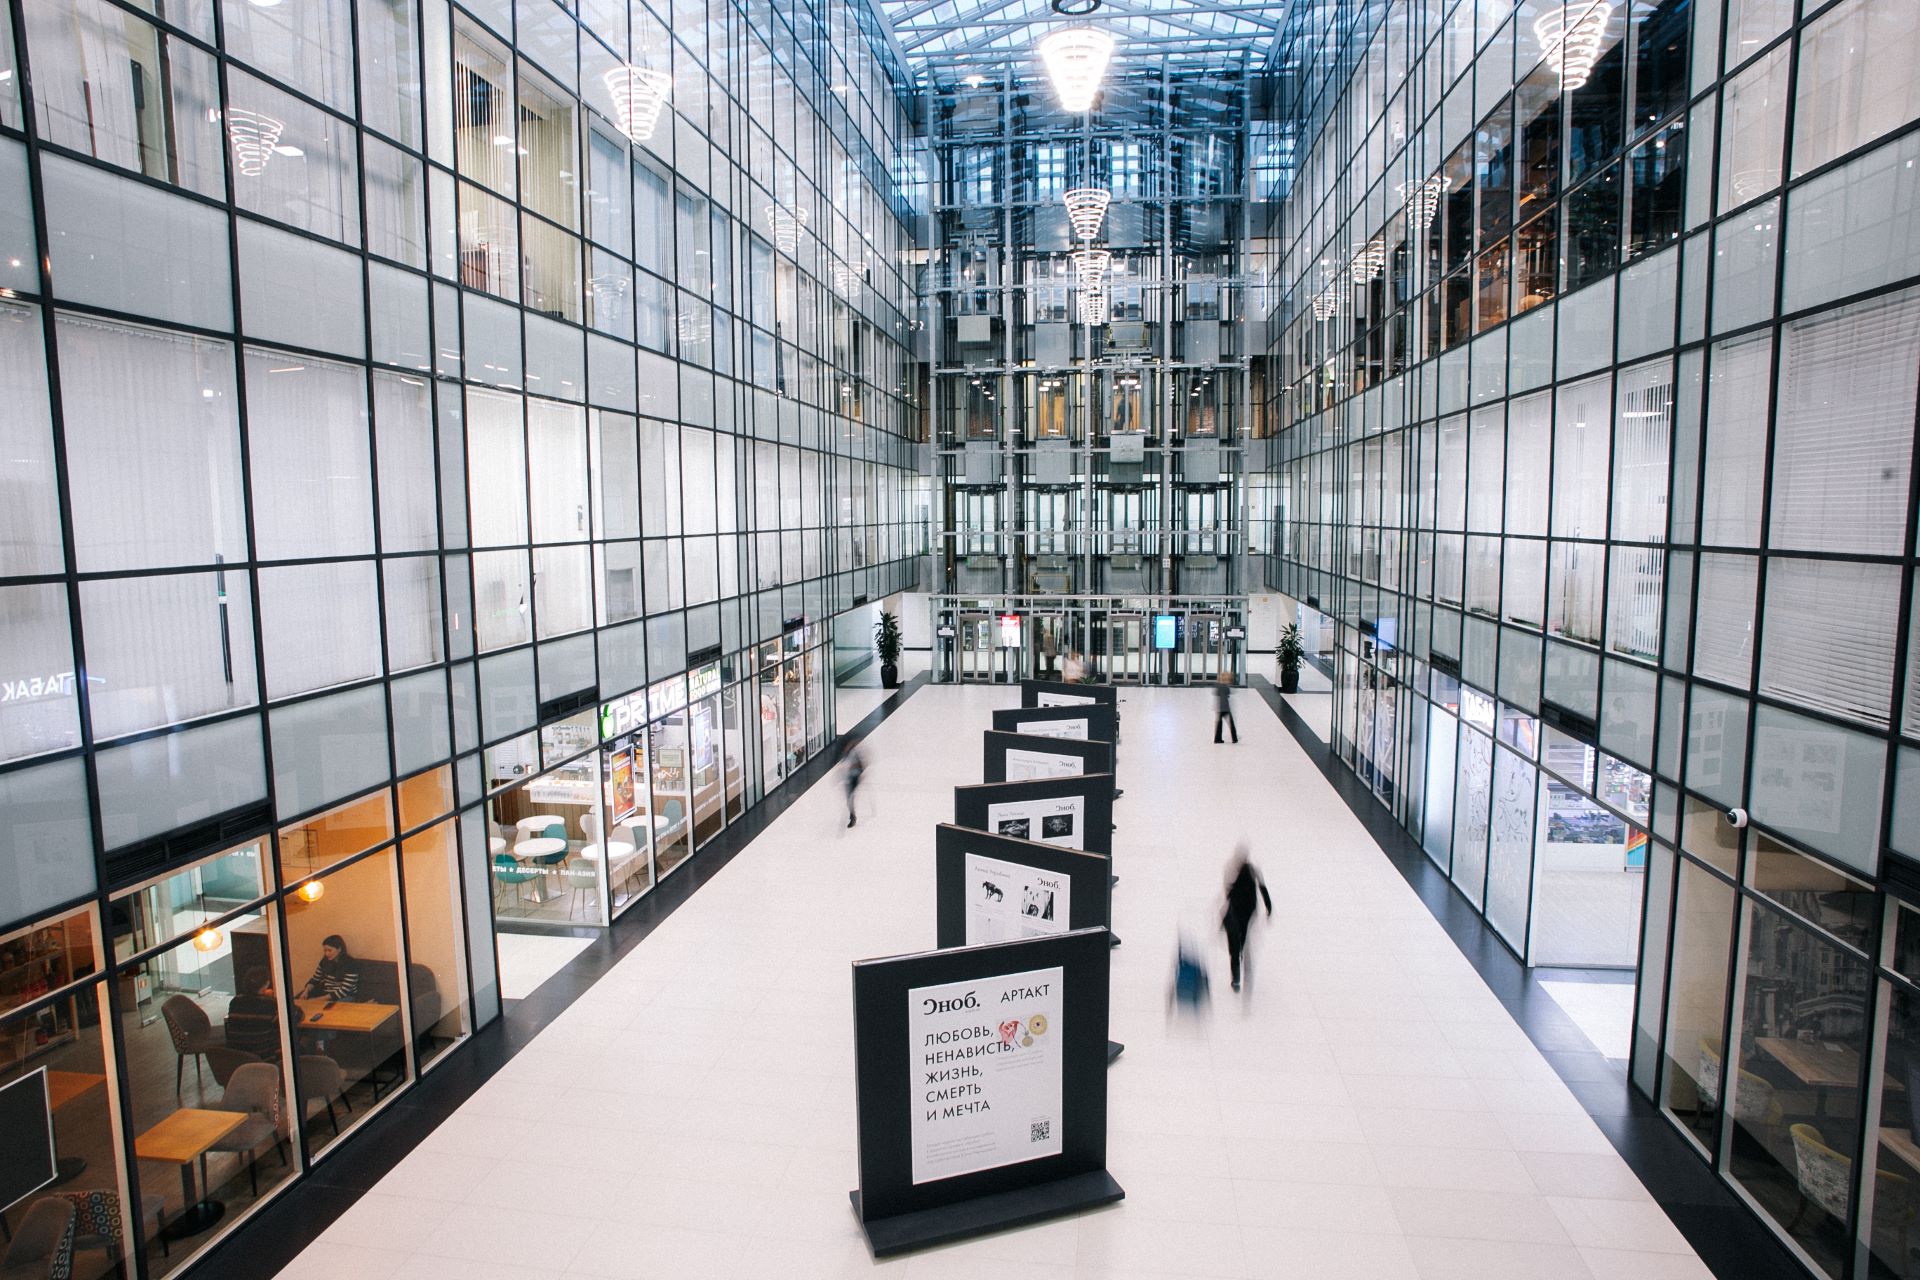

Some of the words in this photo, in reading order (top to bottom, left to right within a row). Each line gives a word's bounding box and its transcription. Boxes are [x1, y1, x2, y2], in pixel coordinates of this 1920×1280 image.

[615, 680, 687, 734] PRIME
[516, 866, 549, 875] ДЕСЕРТЫ
[560, 869, 596, 877] ПАН-АЗИЯ
[1000, 984, 1050, 1003] АРТАКТ
[924, 1025, 994, 1047] ЛЮБОВЬ,
[925, 1040, 1015, 1066] НЕНАВИСТЬ,
[925, 1065, 983, 1085] ЖИЗНЬ,
[925, 1083, 982, 1103] СМЕРТЬ
[926, 1109, 937, 1121] И
[942, 1100, 991, 1119] МЕЧТА
